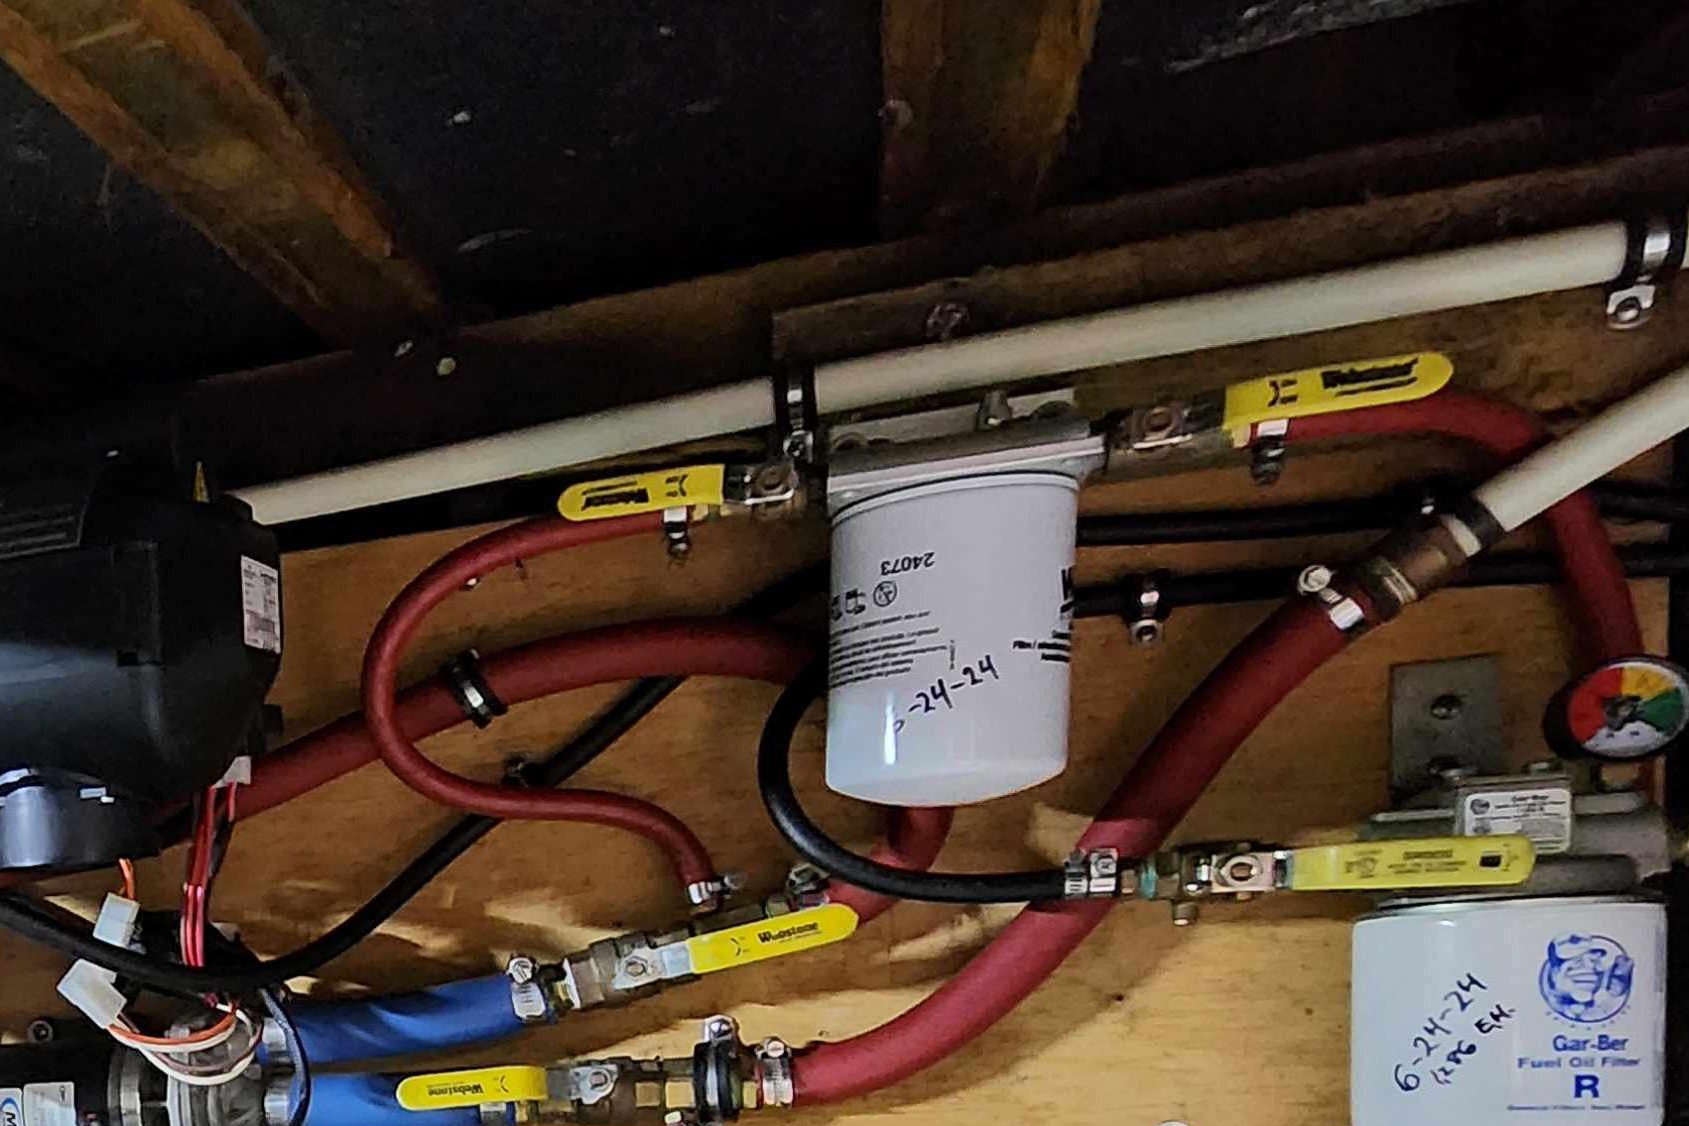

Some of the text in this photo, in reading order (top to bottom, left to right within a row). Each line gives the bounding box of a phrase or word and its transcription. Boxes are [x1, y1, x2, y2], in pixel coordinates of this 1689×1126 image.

[880, 551, 935, 576] 24073
[1394, 972, 1488, 1092] 6-24-24
[1552, 1034, 1630, 1052] Gar-Ber
[1516, 1056, 1641, 1069] Fuel Oil Filter
[1573, 1074, 1601, 1099] R
